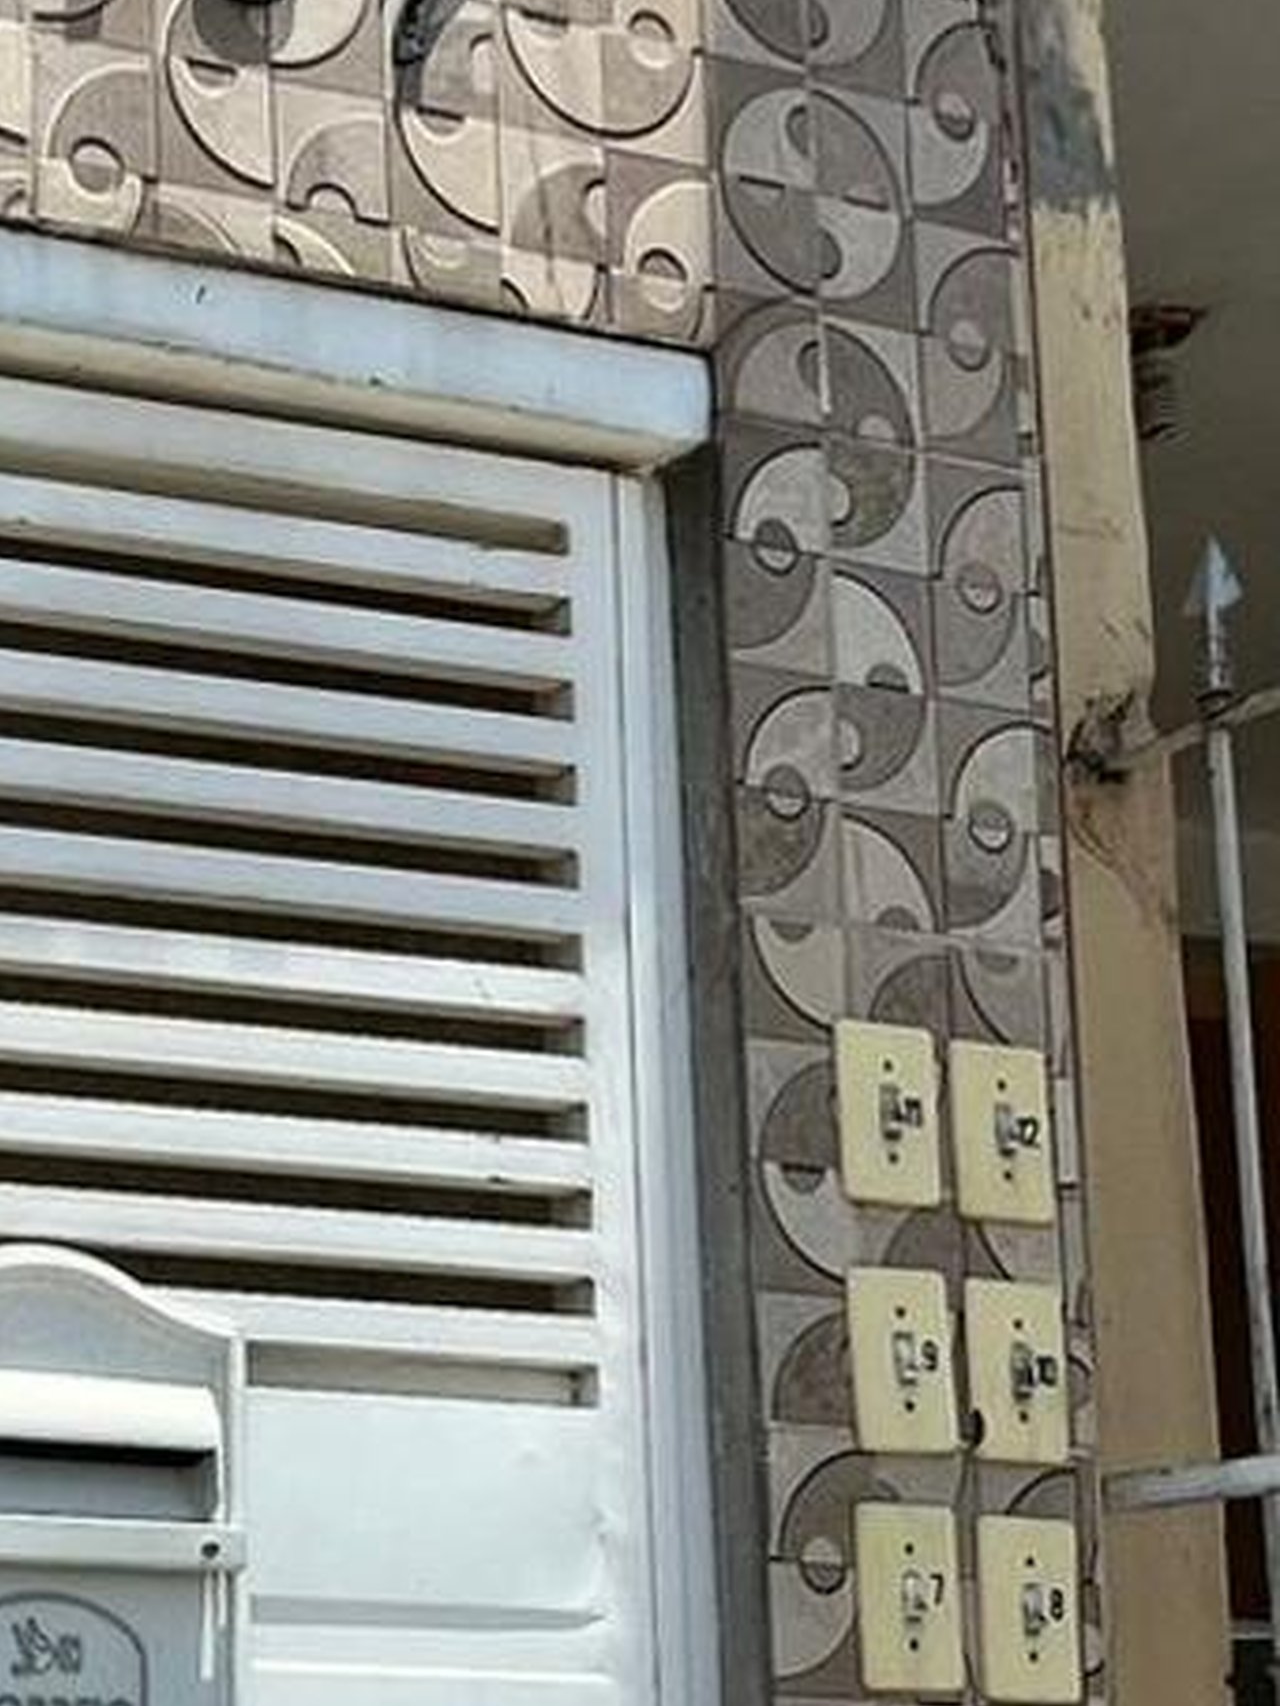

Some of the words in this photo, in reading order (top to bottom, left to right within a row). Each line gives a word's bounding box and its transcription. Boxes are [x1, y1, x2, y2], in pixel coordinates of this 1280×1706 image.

[921, 1339, 939, 1372] 9
[929, 1573, 944, 1606] 7
[1049, 1588, 1065, 1622] 8
